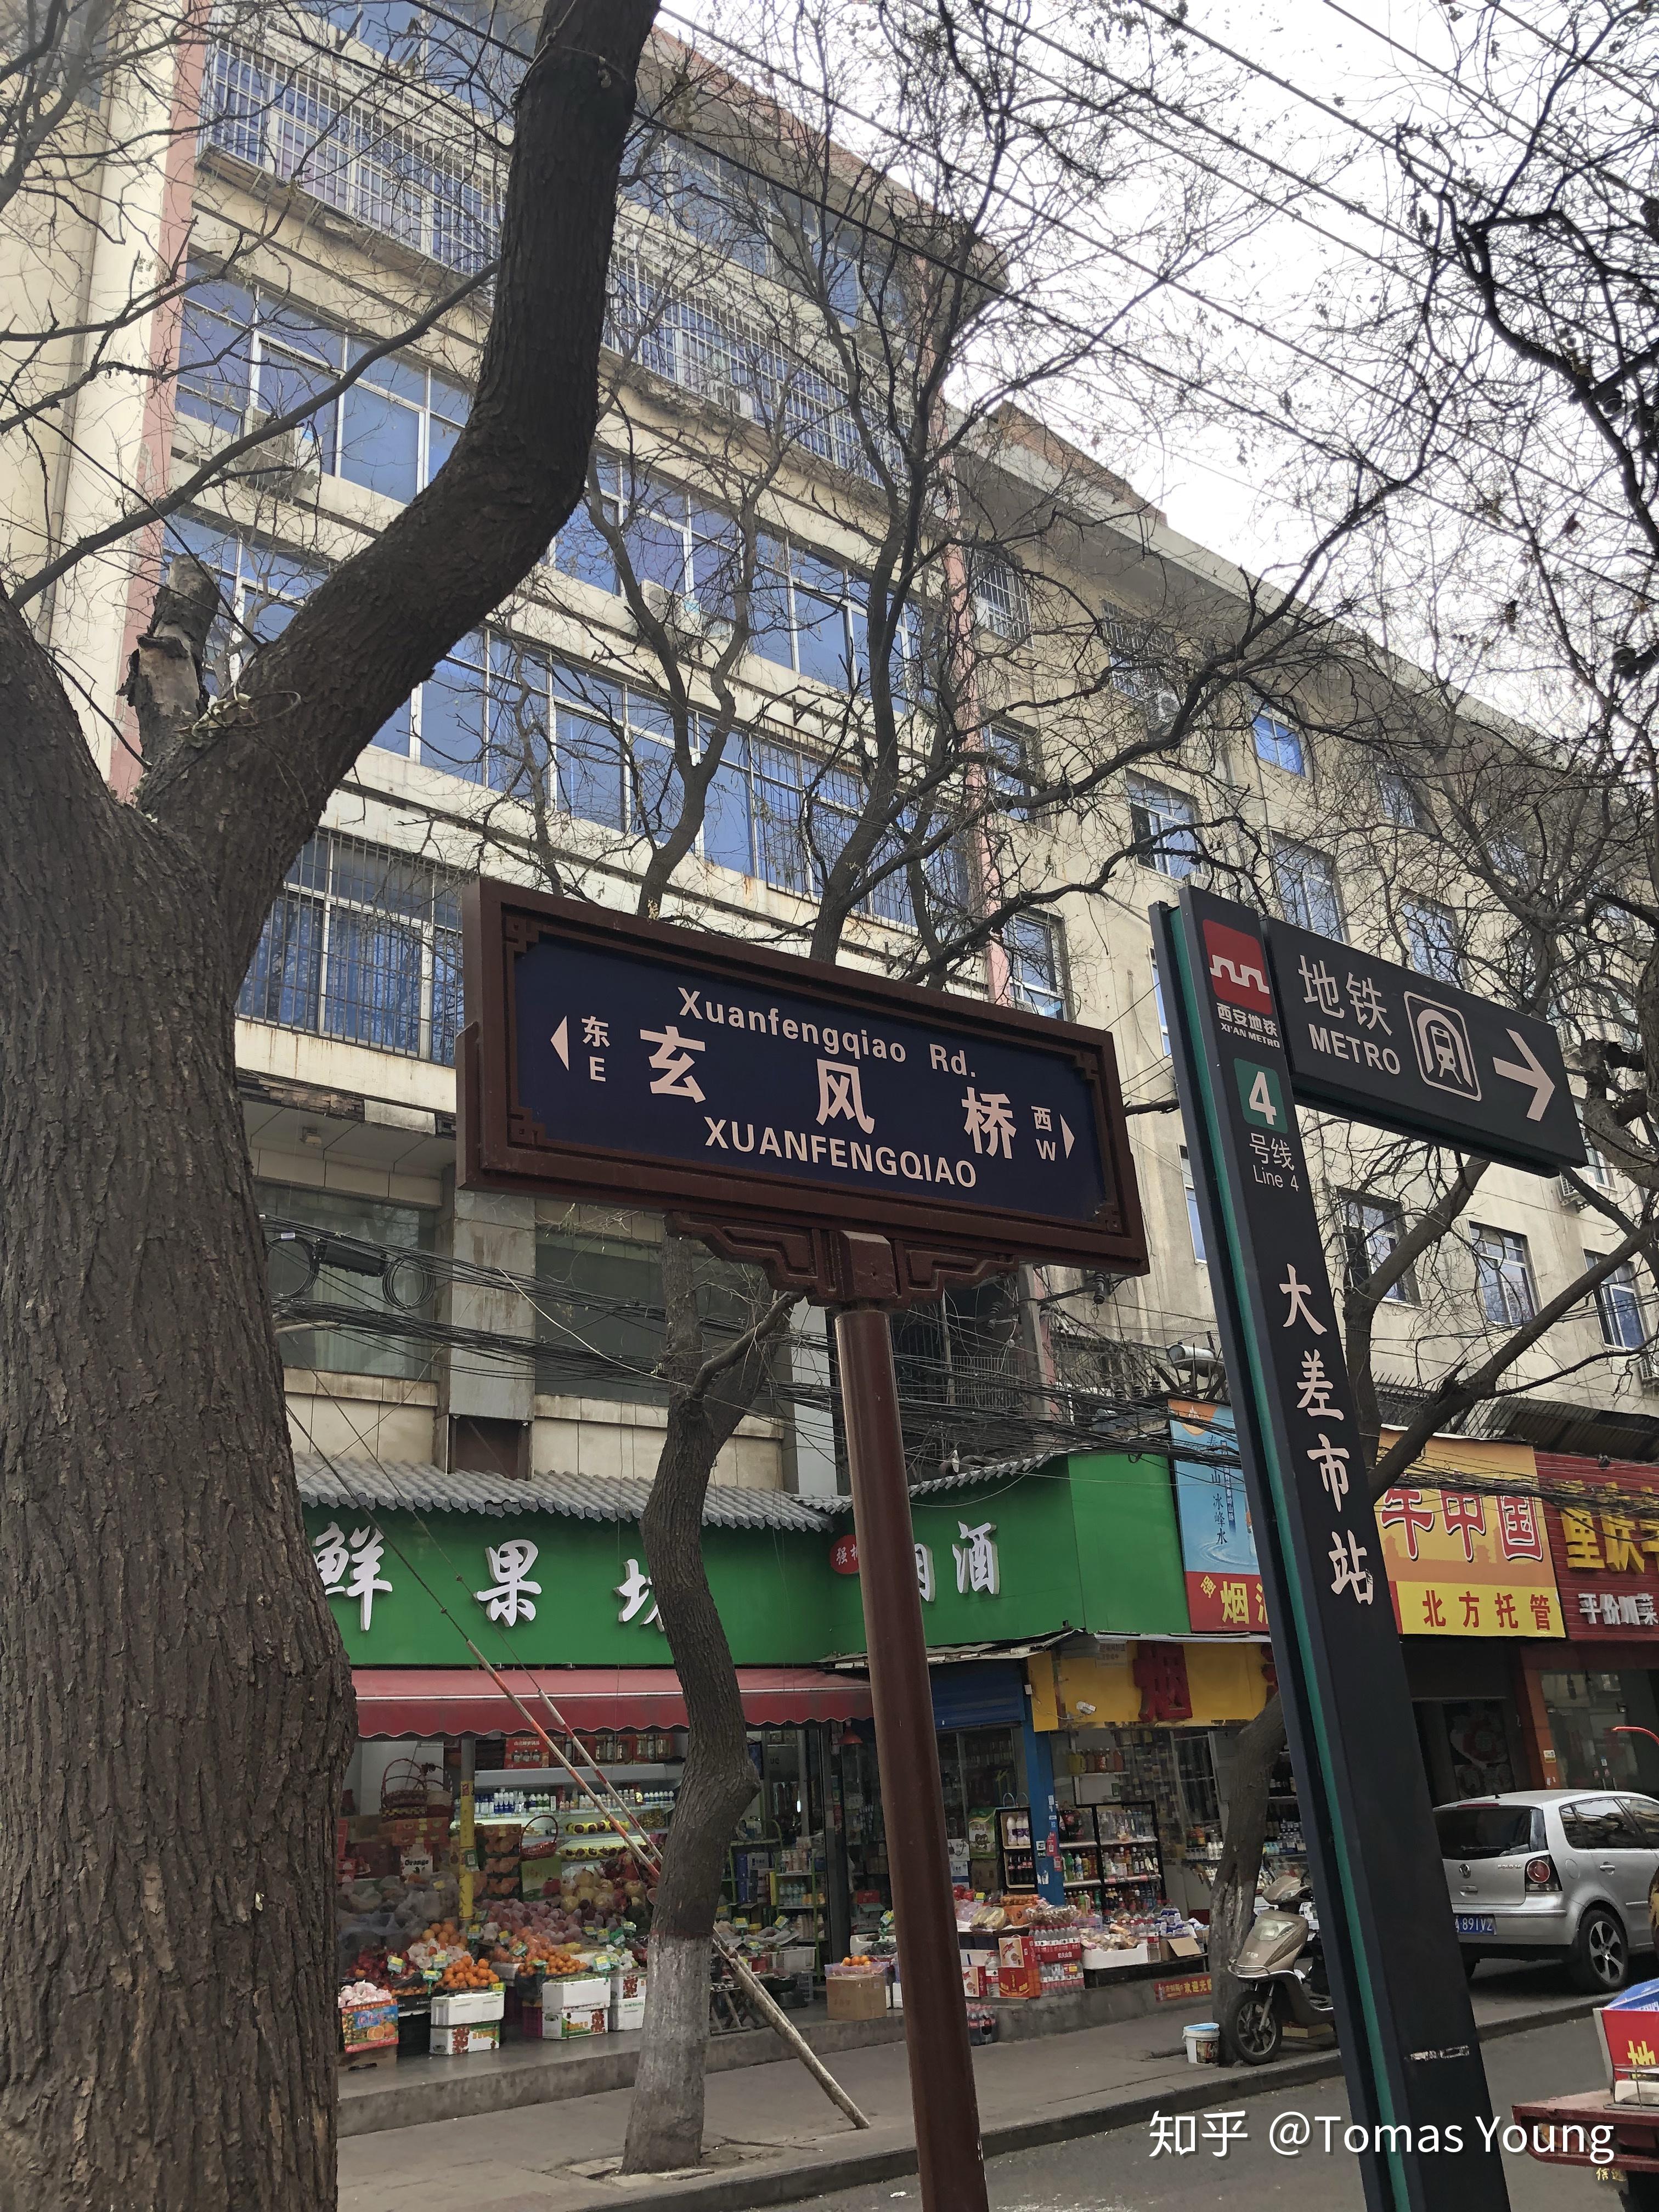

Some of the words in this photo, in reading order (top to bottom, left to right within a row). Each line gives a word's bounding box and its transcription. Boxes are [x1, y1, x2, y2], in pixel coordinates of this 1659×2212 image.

[1298, 955, 1392, 1037] 地铁
[581, 1015, 610, 1048] 东
[678, 987, 906, 1063] Xuanfengqiao
[929, 1042, 977, 1077] Rd.
[1216, 1002, 1278, 1038] 西安地铁
[1220, 1022, 1247, 1039] XI'AN
[1248, 1031, 1281, 1049] METRO
[1308, 1024, 1401, 1075] METRO
[589, 1057, 606, 1082] E
[640, 1026, 1017, 1159] 玄风桥
[1249, 1071, 1277, 1125] 4
[1032, 1106, 1052, 1132] 西
[704, 1116, 977, 1188] XUANFENGQIAO
[1036, 1139, 1056, 1161] W
[1249, 1132, 1295, 1171] 号线
[1252, 1164, 1284, 1188] Line
[1290, 1175, 1300, 1192] 4
[1279, 1263, 1374, 1606] 大差市站
[1422, 1590, 1551, 1630] 北方托管
